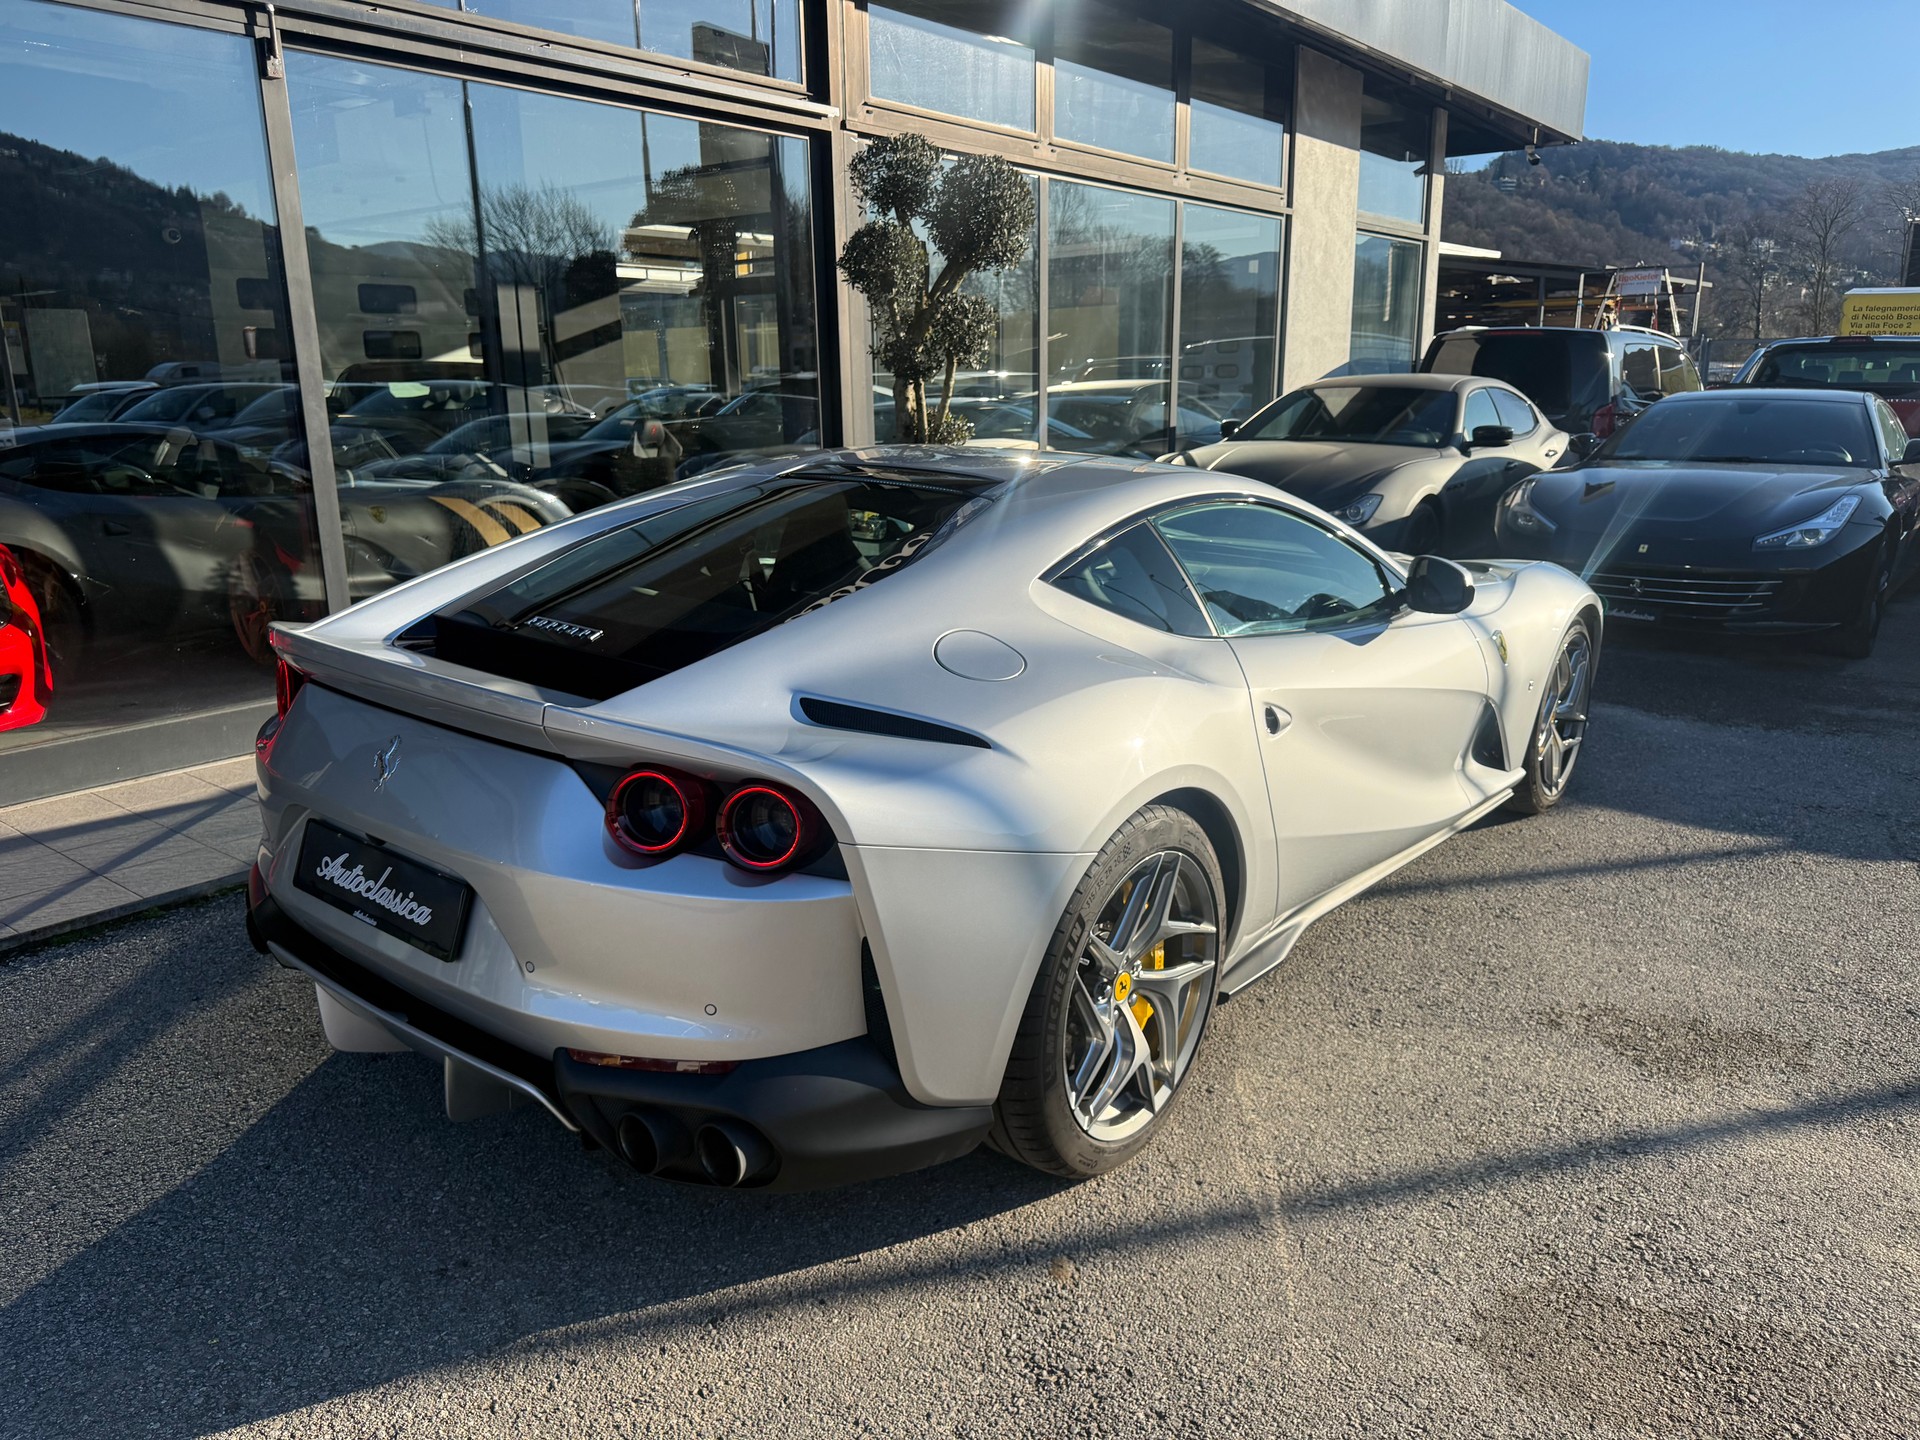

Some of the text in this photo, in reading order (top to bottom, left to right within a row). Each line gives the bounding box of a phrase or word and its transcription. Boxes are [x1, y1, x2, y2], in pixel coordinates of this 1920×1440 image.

[1861, 313, 1894, 321] Niccolò
[1865, 305, 1920, 313] falegnameria
[316, 852, 433, 926] Autoclassica
[1045, 921, 1084, 1055] MICHELIN
